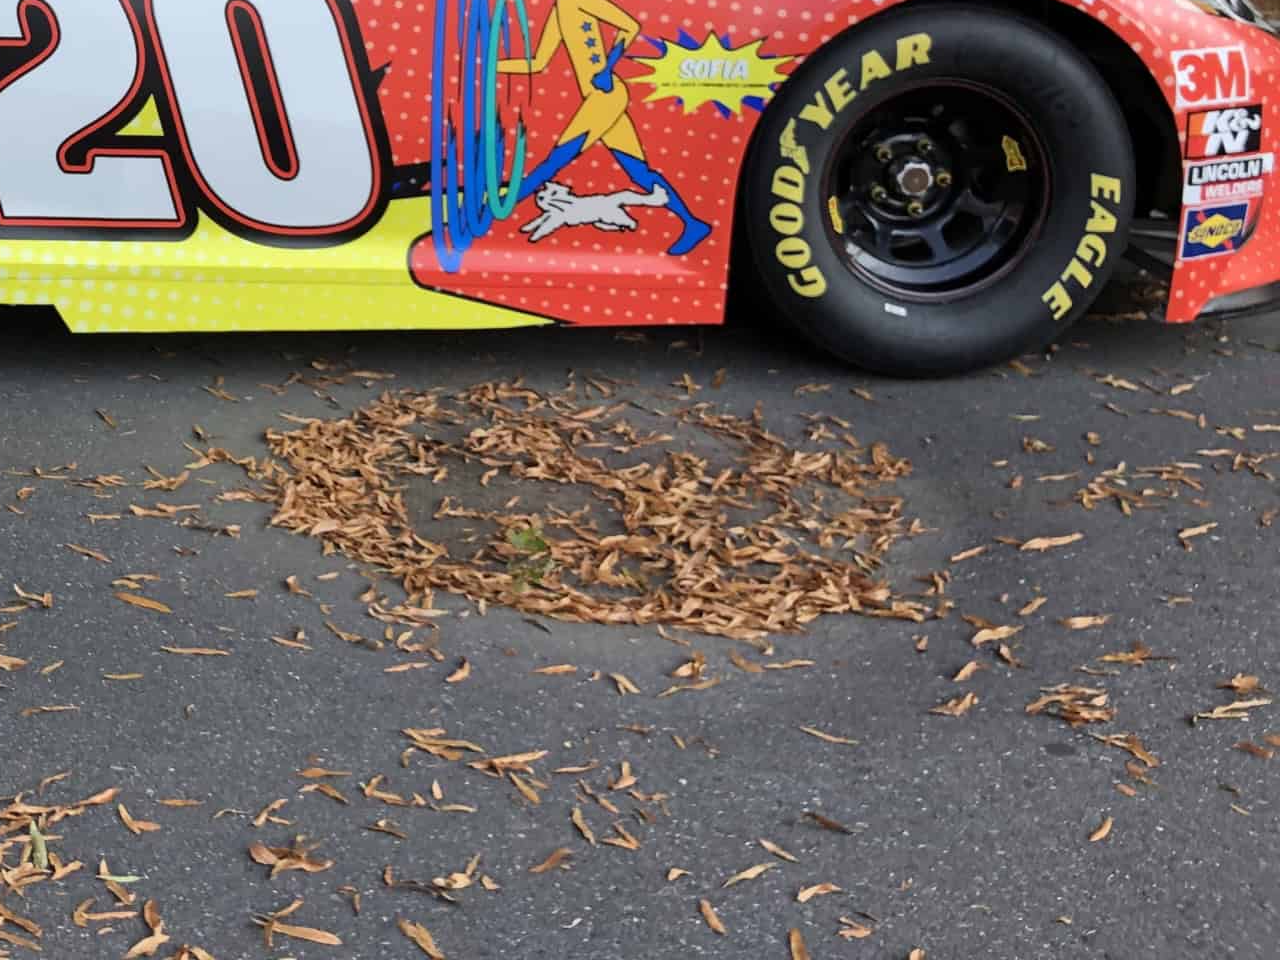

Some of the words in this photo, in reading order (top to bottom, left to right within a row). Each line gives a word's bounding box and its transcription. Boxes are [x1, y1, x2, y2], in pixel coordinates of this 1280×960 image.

[679, 58, 750, 81] SOFIA
[1176, 50, 1248, 104] 3M
[1191, 159, 1261, 185] LINCOLN
[1189, 221, 1243, 242] SUNOCO
[1040, 172, 1121, 321] EAGLE
